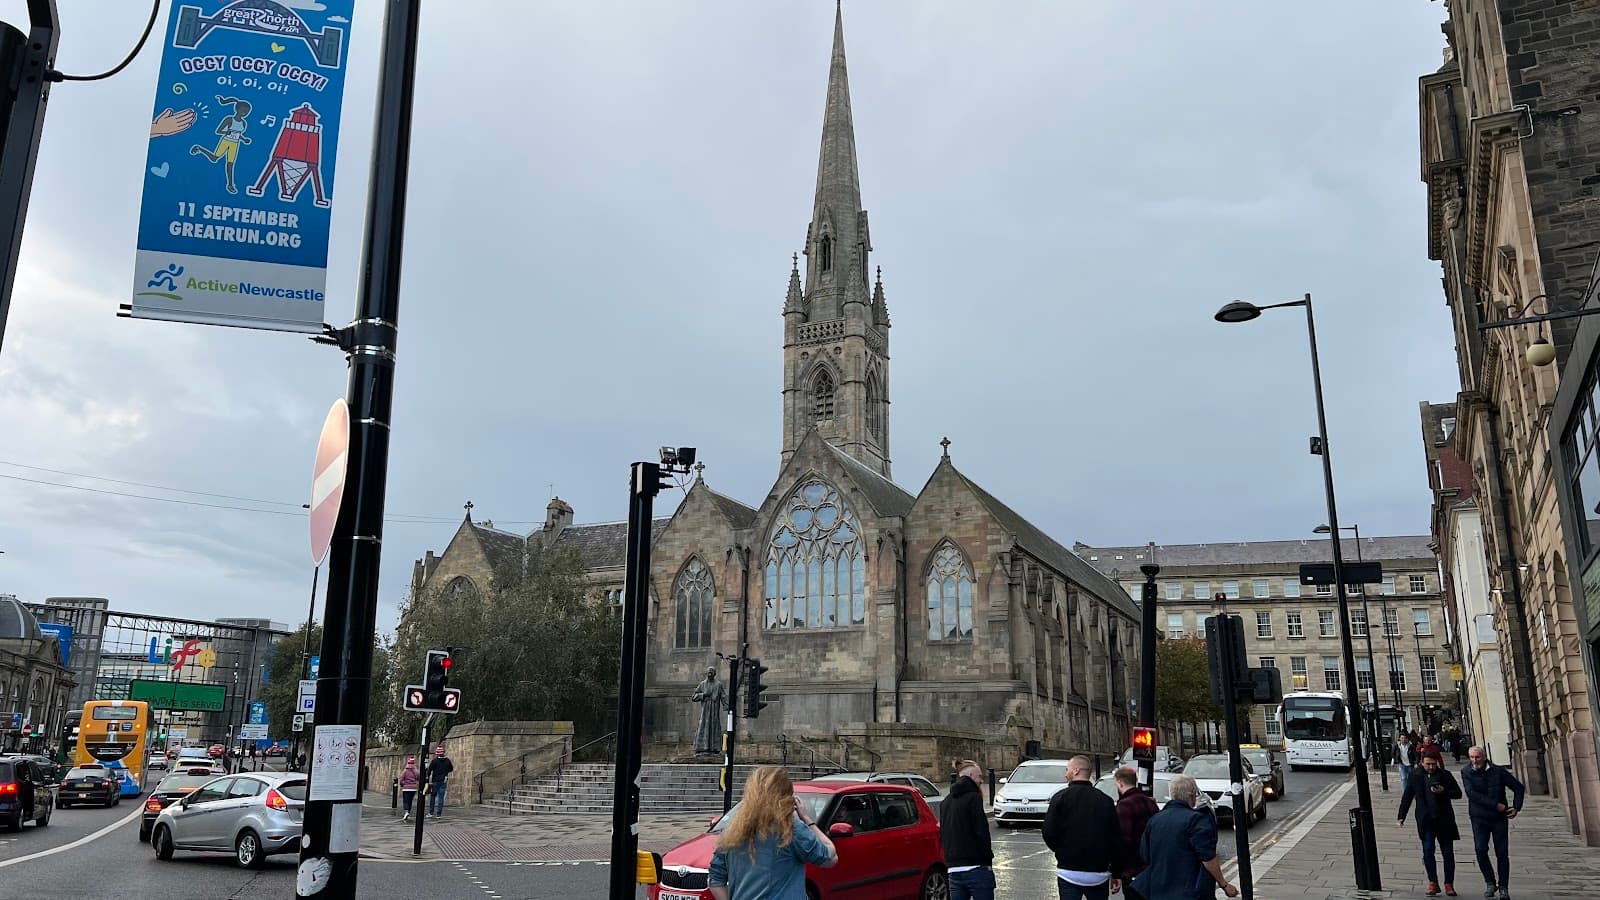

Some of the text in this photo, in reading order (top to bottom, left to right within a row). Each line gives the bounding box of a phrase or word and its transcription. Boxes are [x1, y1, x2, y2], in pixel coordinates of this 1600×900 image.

[223, 9, 300, 26] great north
[280, 25, 299, 33] run
[180, 56, 328, 92] OGGY OGGY OGGY!
[179, 201, 299, 228] 11 SEPTEMBER
[169, 220, 301, 248] GREATRUN.ORG
[186, 277, 324, 301] ActiveNewcastle
[149, 636, 216, 671] Life
